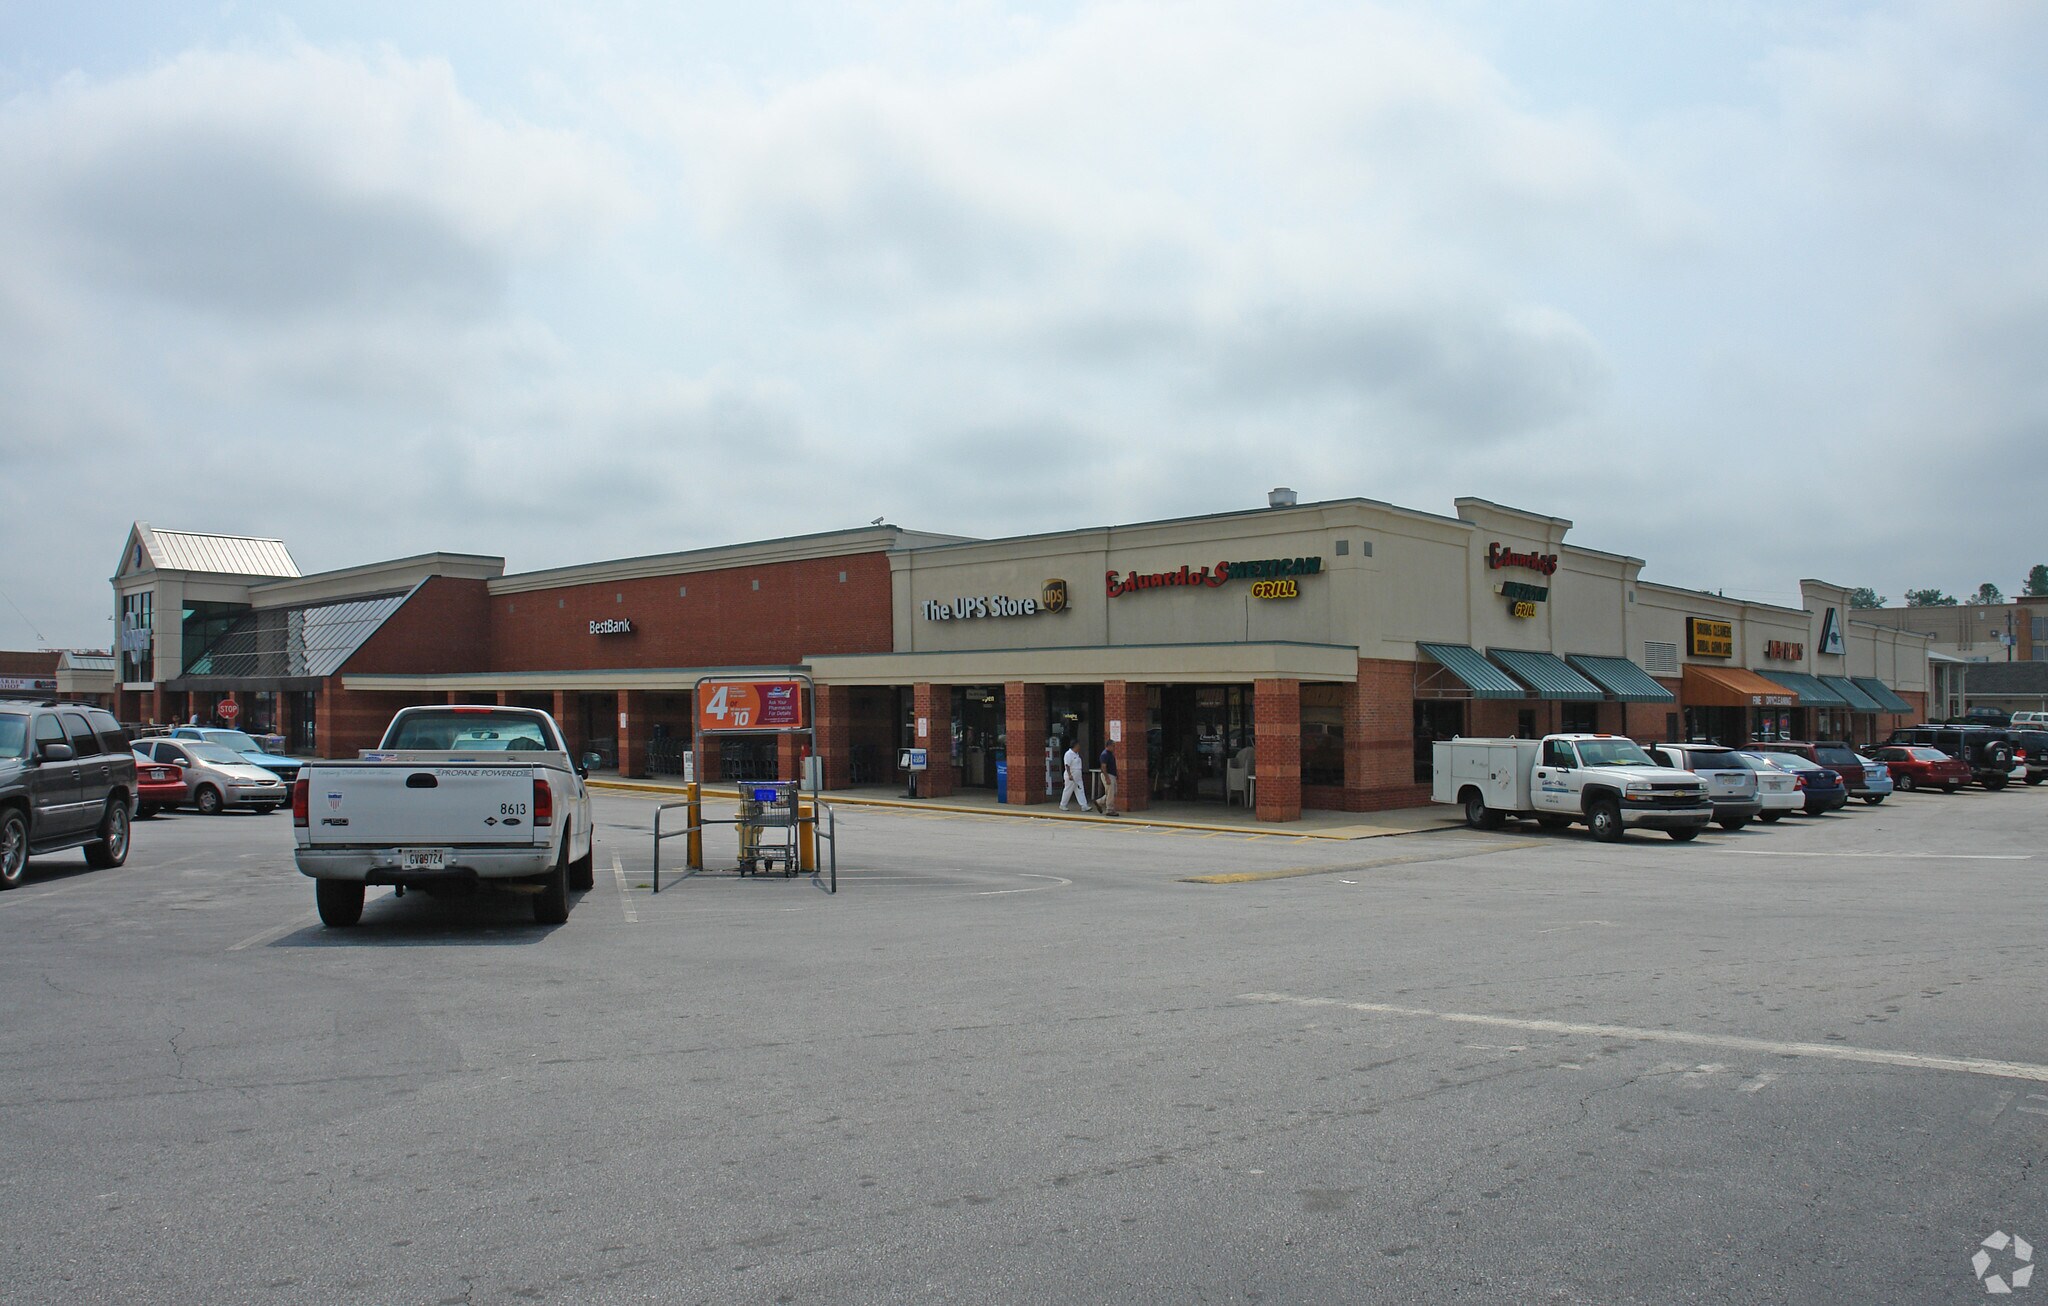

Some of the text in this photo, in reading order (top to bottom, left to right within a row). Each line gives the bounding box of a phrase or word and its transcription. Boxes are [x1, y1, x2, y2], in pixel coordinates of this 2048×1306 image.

[1252, 580, 1299, 599] GRILL
[922, 595, 1036, 621] The UPS Store
[1514, 601, 1537, 618] GRILL
[589, 618, 631, 635] BestBank
[220, 705, 238, 713] STOP
[441, 769, 525, 778] PROPANE POWERED
[500, 803, 526, 815] 8613
